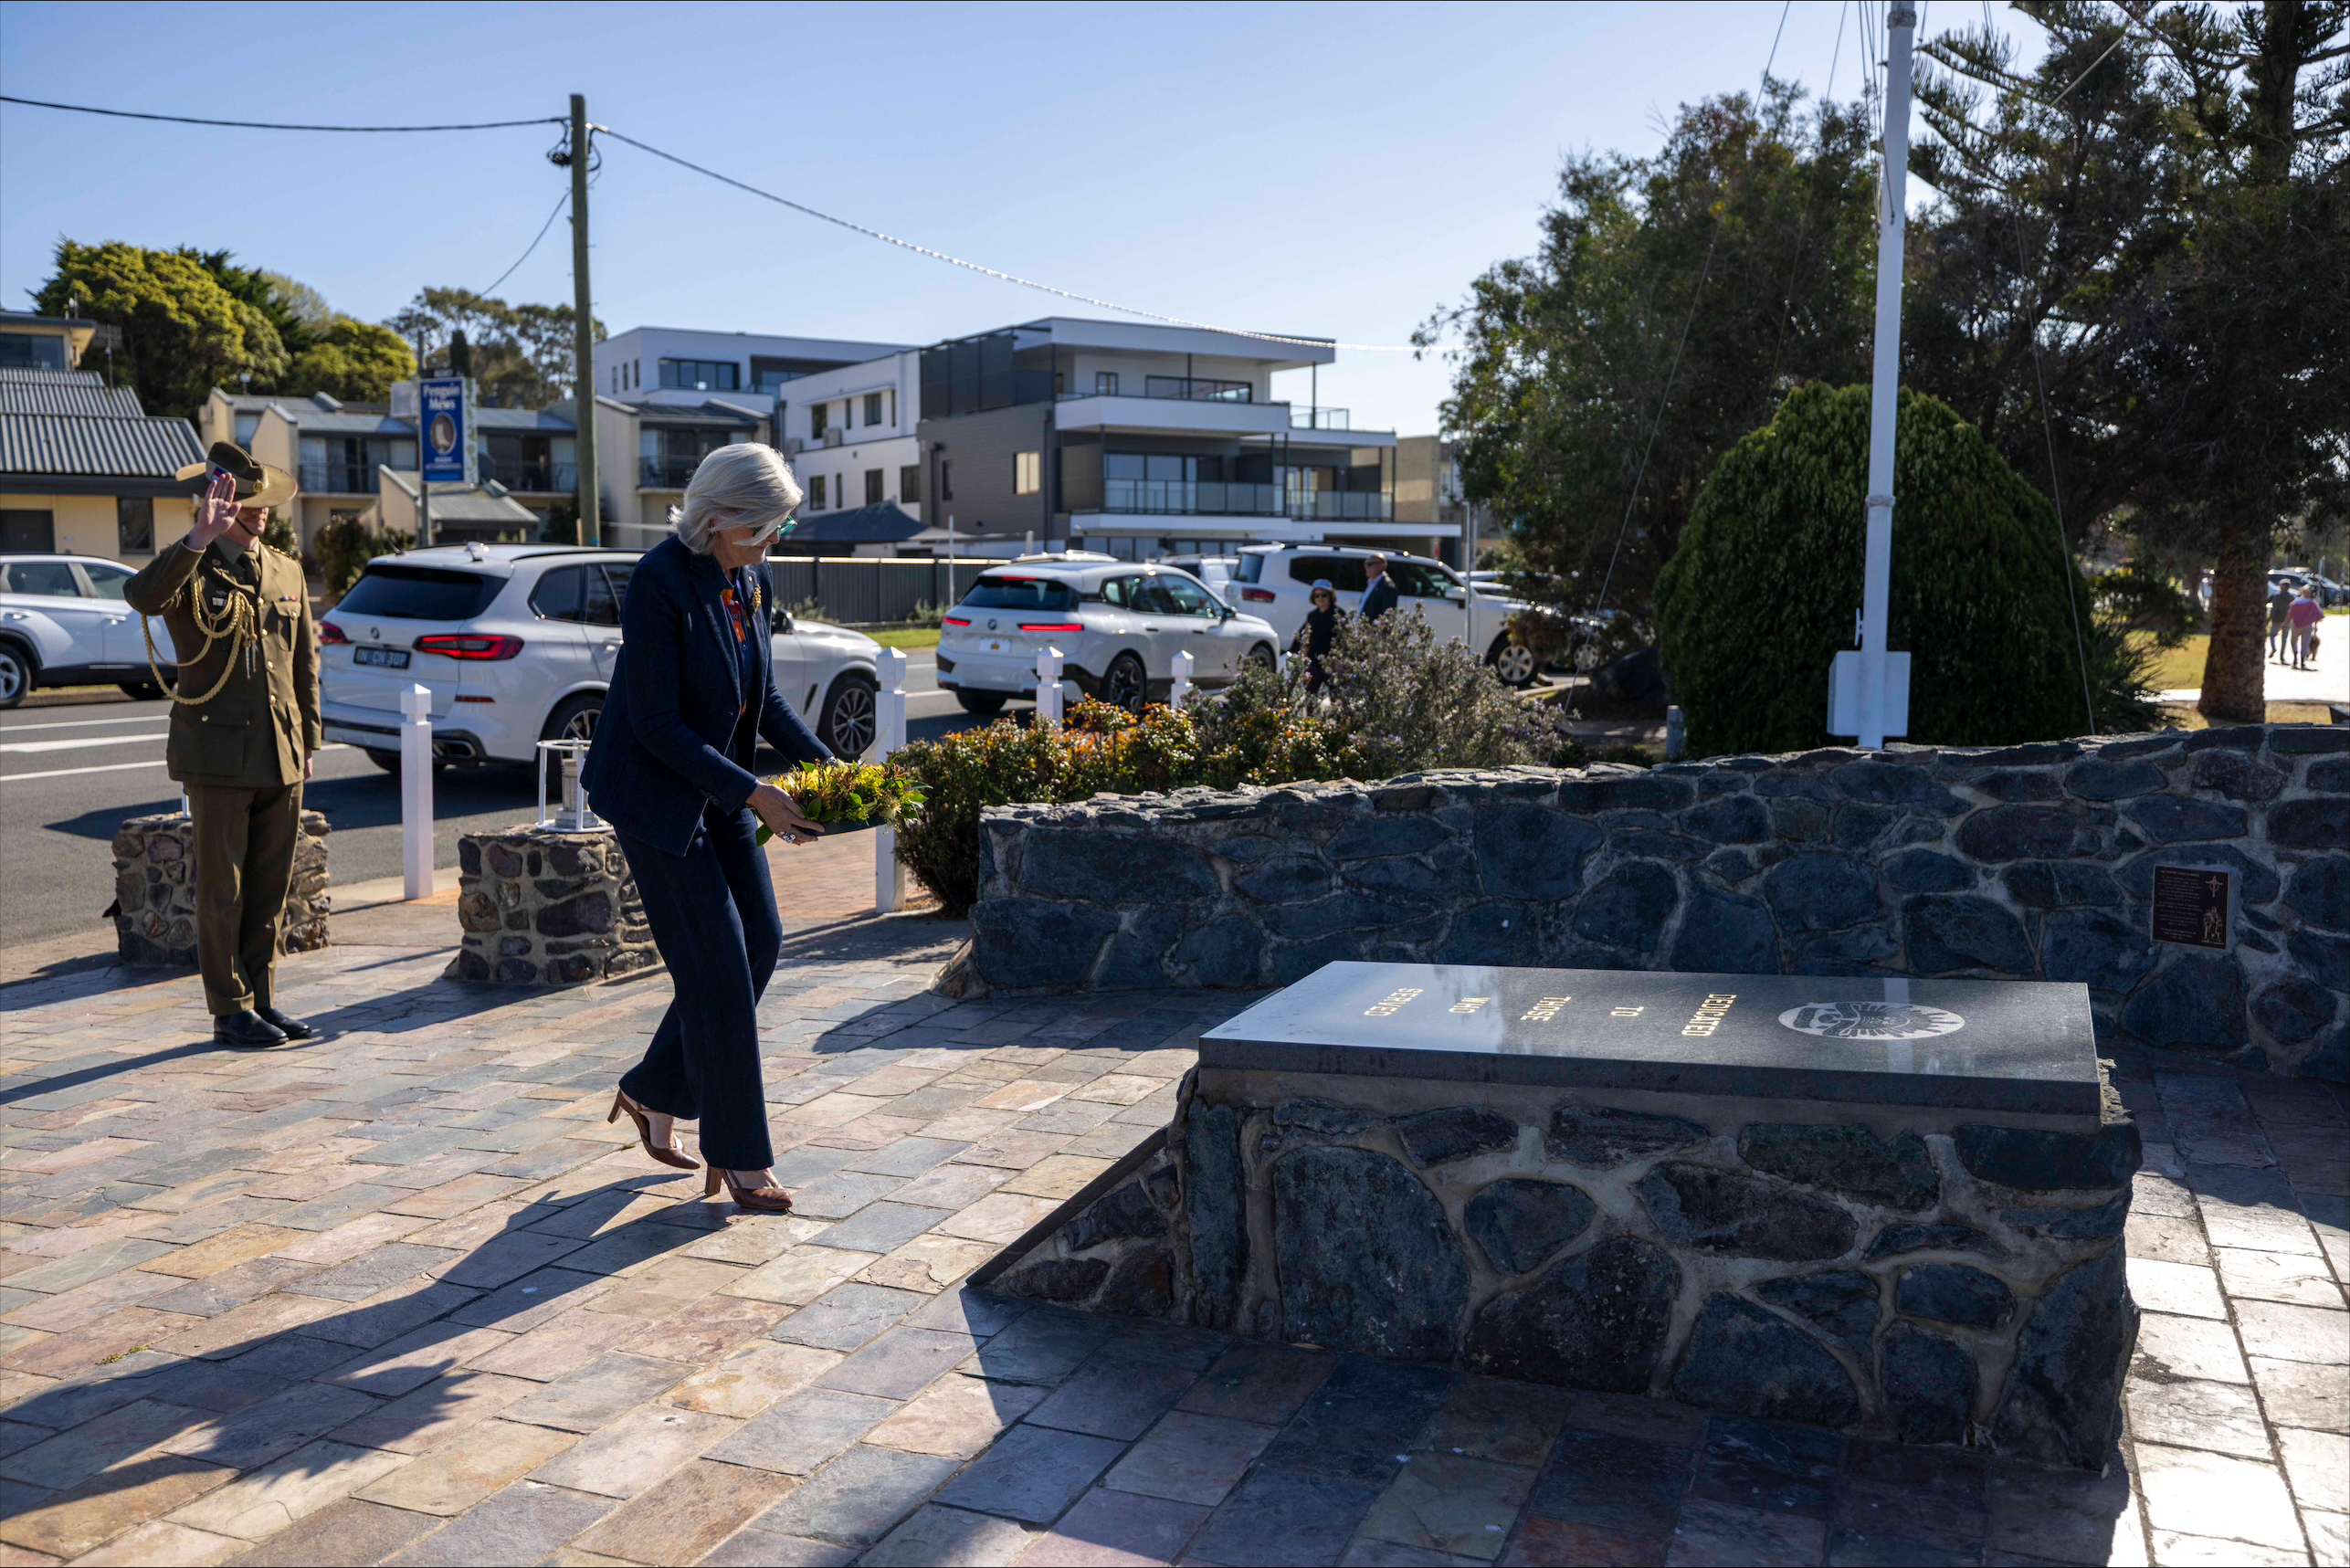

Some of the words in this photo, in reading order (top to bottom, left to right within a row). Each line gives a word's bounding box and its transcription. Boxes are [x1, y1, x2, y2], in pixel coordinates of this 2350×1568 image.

[423, 383, 460, 398] Penguin
[428, 398, 456, 410] Mews
[1364, 987, 1425, 1017] SERVED
[1449, 997, 1491, 1014] WHO
[1520, 996, 1572, 1022] THOSE
[1610, 1006, 1645, 1018] TO
[1681, 994, 1737, 1037] DEDICATED
